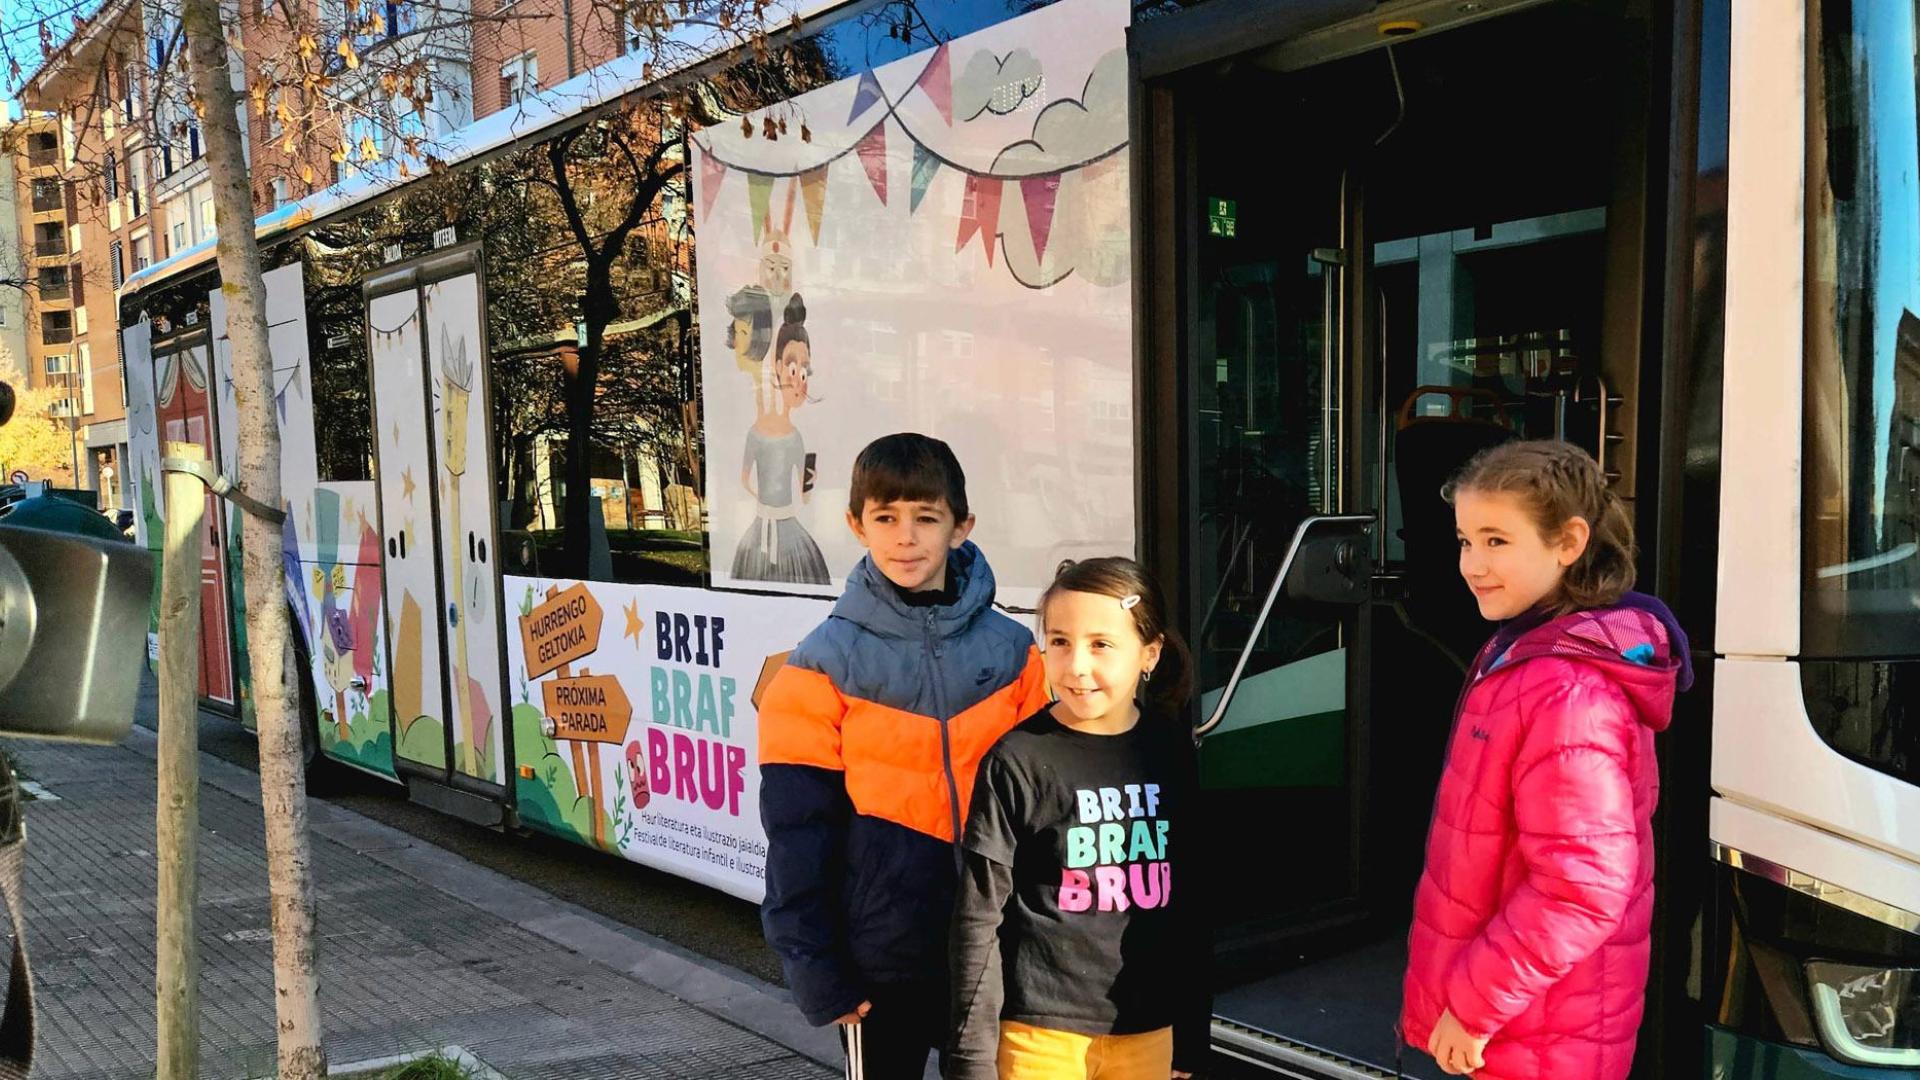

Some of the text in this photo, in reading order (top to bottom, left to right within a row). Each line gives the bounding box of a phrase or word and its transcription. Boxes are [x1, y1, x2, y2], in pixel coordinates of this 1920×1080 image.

[530, 595, 586, 641] HURRENGO
[656, 611, 725, 668] BRIF
[538, 623, 586, 664] GELTOKIA
[556, 682, 606, 706] PRÓXIMA
[650, 666, 736, 738] BRAF
[561, 712, 608, 733] PARADA
[648, 727, 745, 817] BRUF
[1076, 784, 1160, 824] BRIF
[634, 827, 659, 846] Festival
[659, 833, 667, 848] de
[668, 836, 701, 859] literatura
[701, 846, 729, 867] infantil
[729, 857, 735, 870] e
[657, 813, 689, 835] literatura
[690, 824, 702, 838] eta
[703, 826, 737, 849] ilustrazio
[1067, 820, 1170, 868] BRAF
